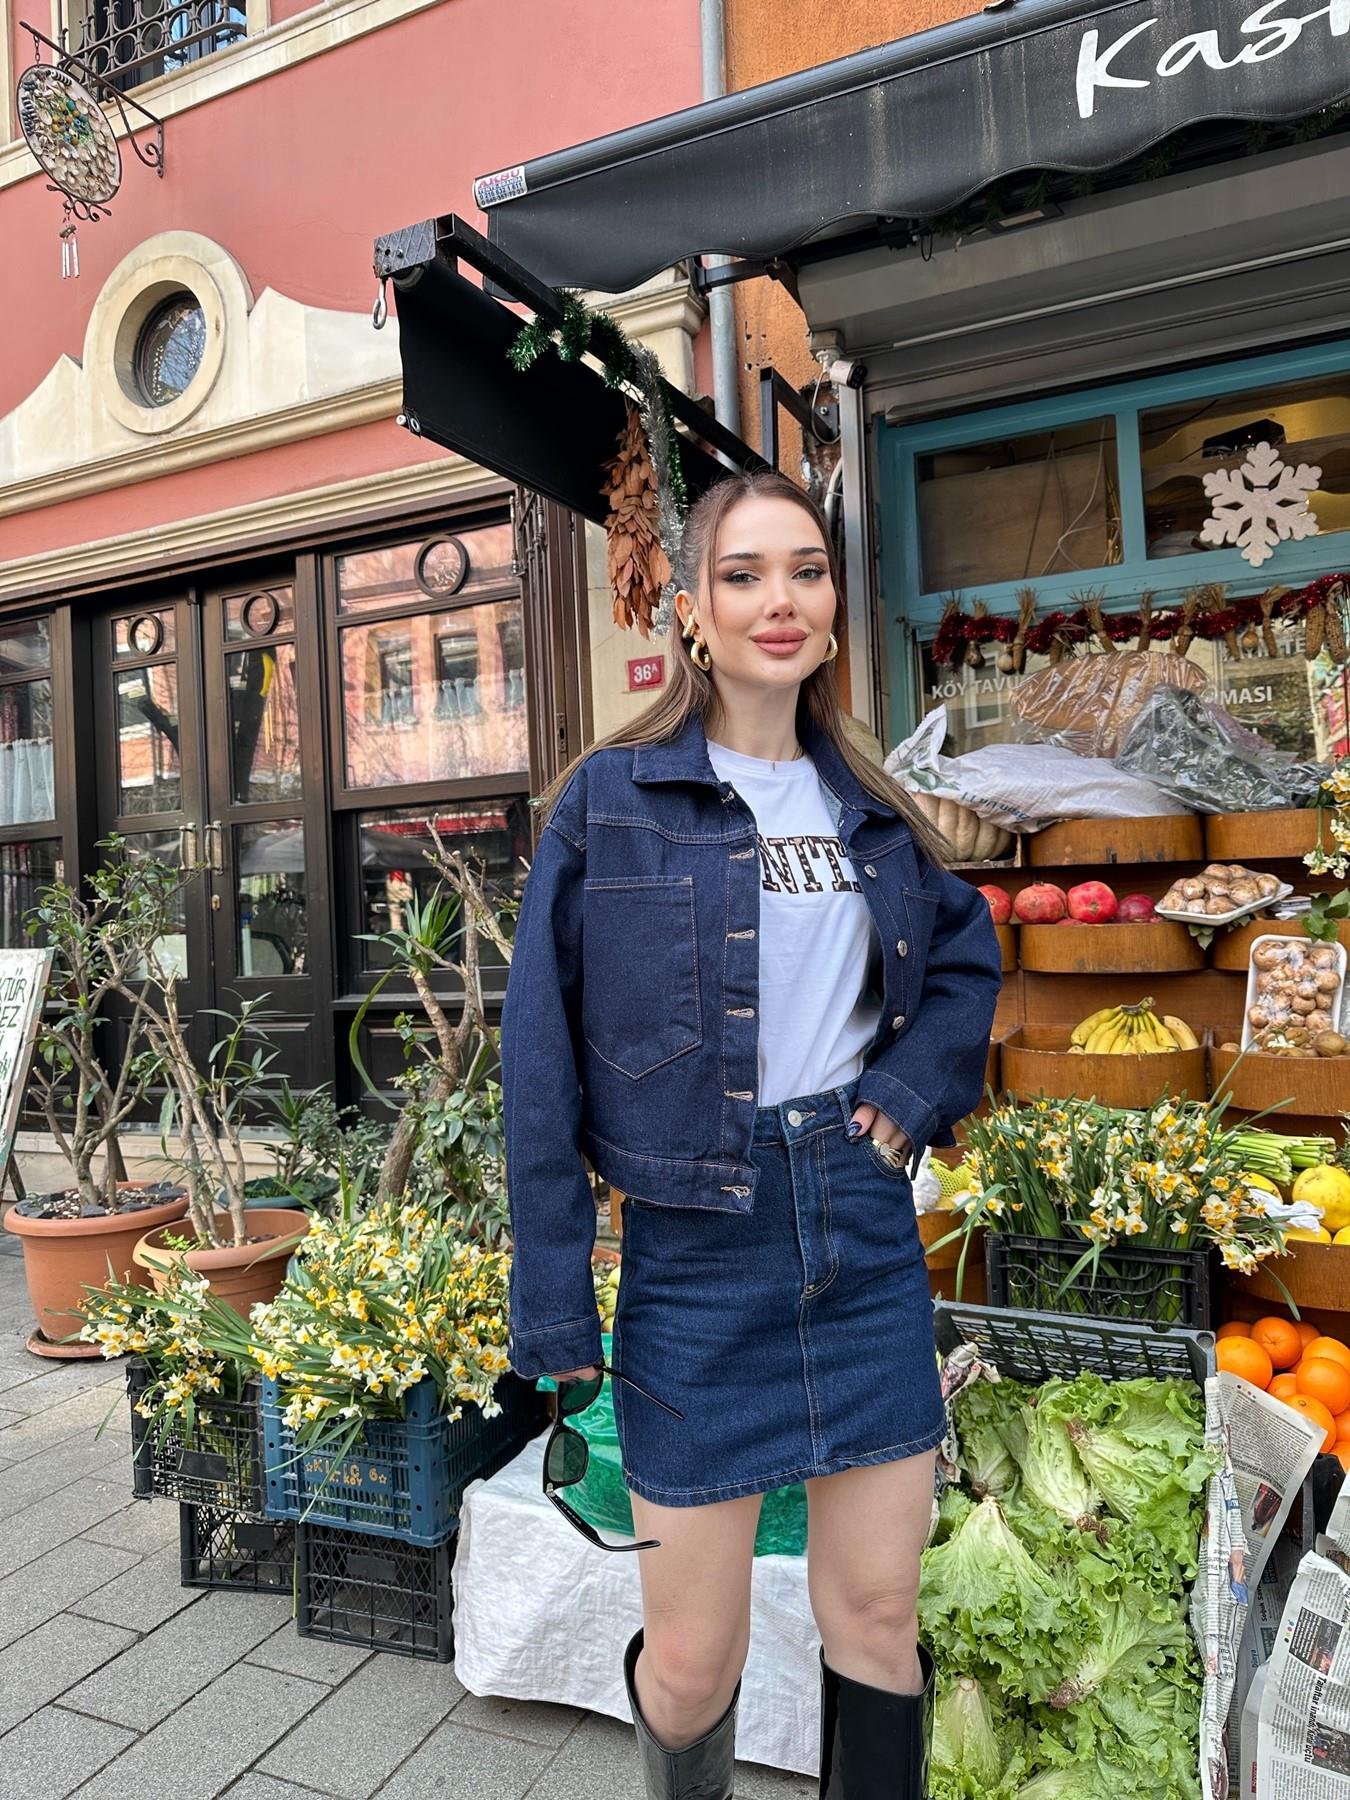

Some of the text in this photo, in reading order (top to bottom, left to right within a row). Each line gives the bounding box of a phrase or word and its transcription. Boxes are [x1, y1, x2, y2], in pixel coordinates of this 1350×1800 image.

[478, 169, 519, 190] AKSU
[633, 663, 659, 684] 36A
[932, 680, 967, 700] KÖY
[757, 833, 864, 893] NIT
[1311, 1675, 1327, 1705] Taraftar
[1303, 1743, 1313, 1763] uçtu
